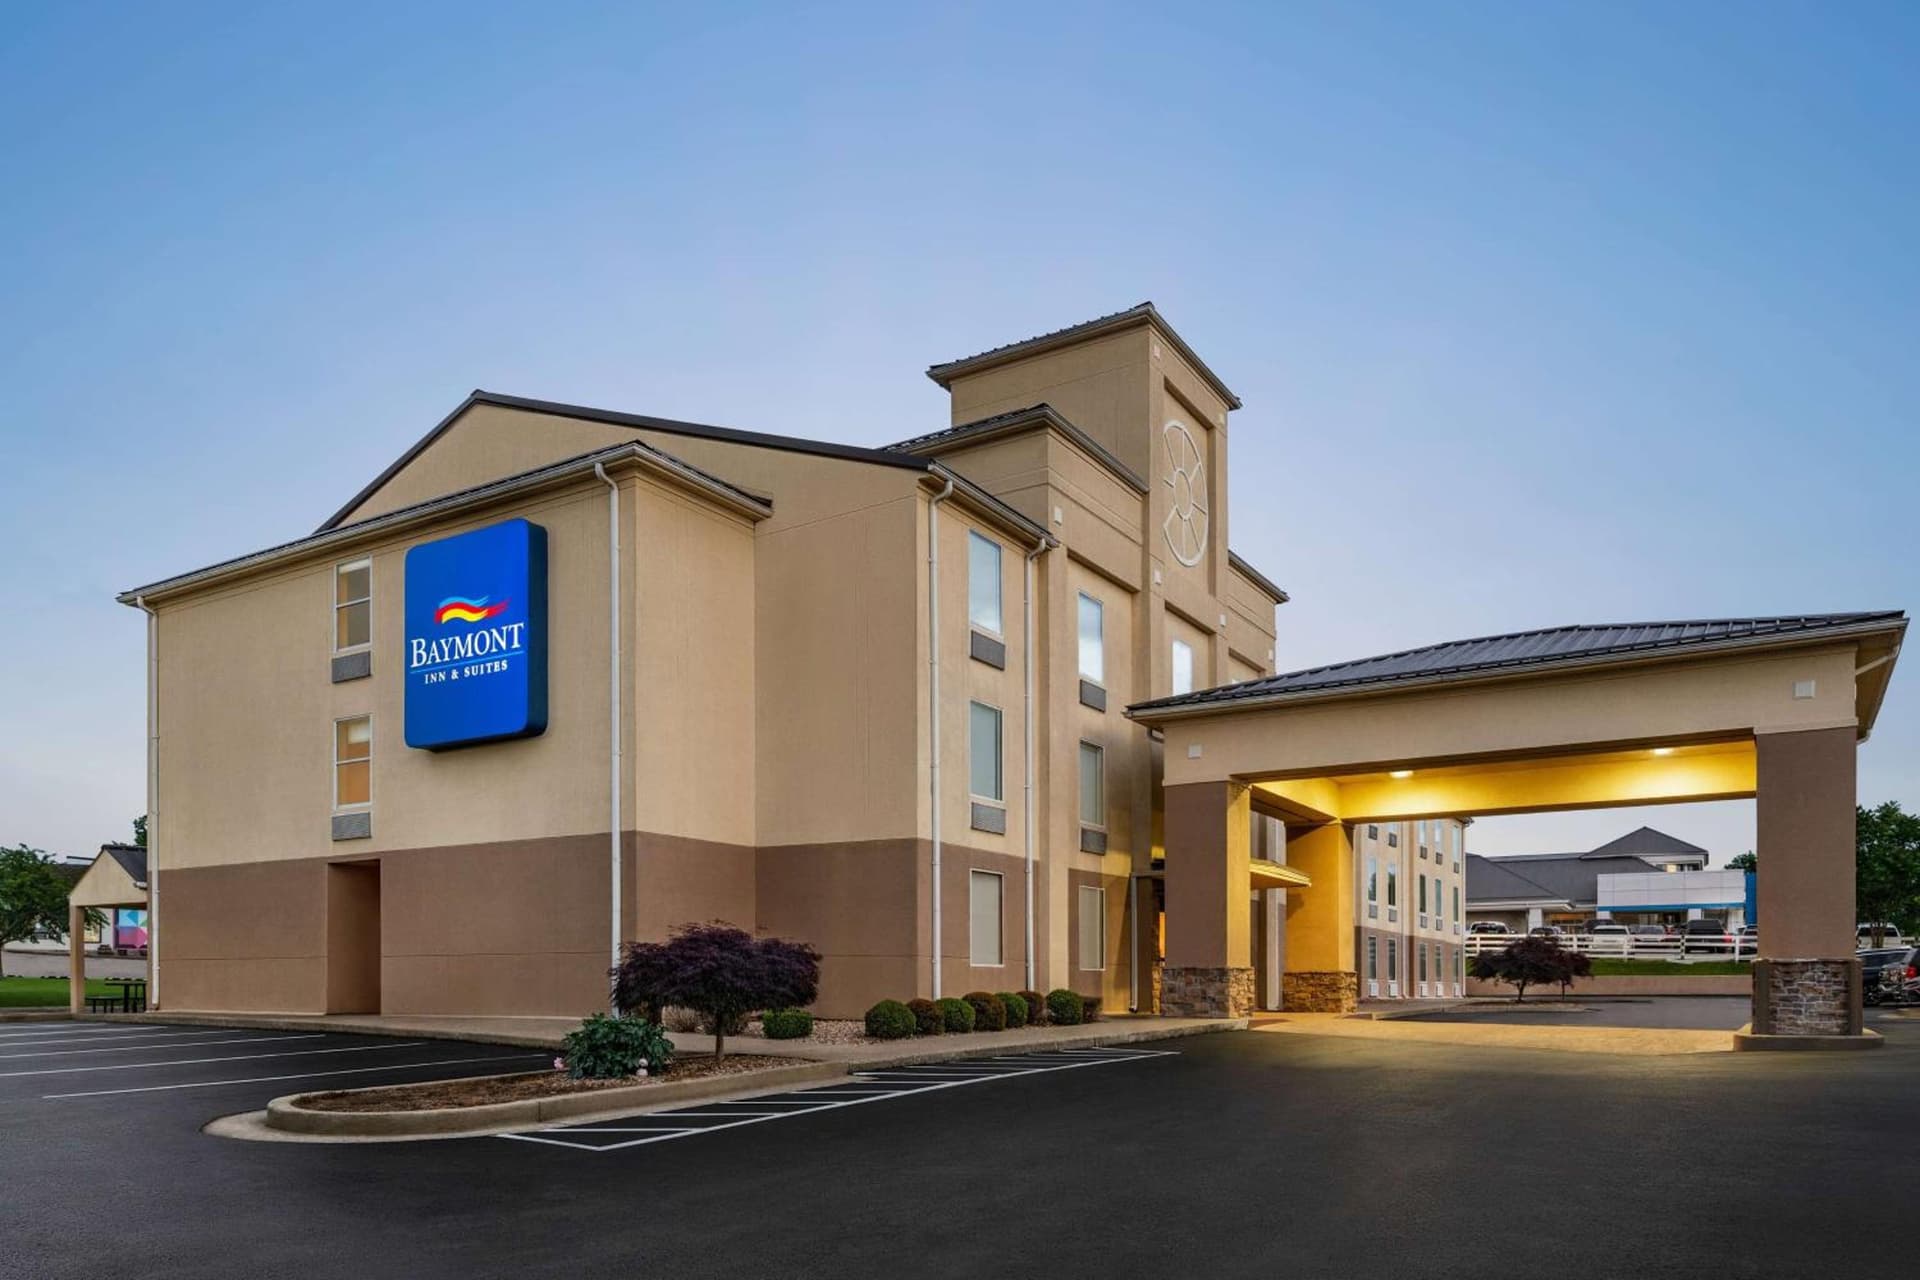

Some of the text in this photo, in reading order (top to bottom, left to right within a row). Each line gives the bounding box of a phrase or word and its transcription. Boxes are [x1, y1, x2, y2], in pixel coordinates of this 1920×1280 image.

[410, 622, 525, 668] BAYMONT
[424, 659, 508, 685] INN & SUITES
